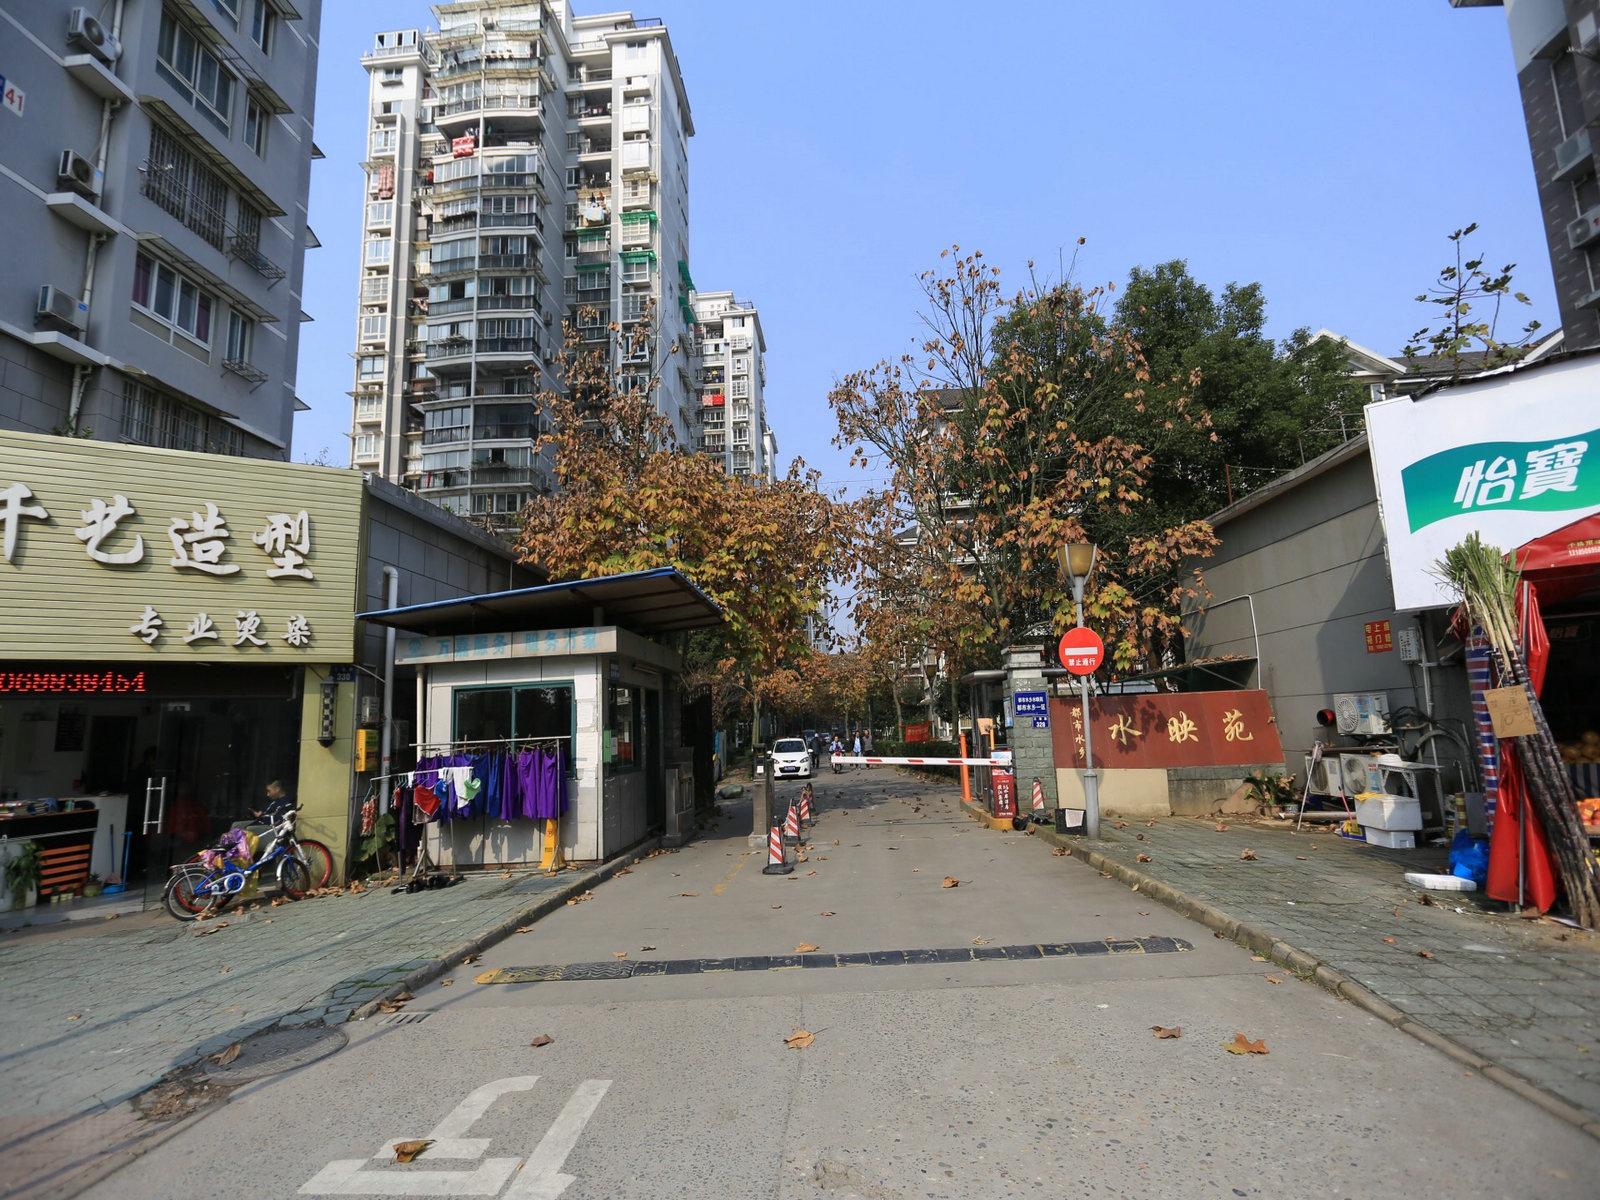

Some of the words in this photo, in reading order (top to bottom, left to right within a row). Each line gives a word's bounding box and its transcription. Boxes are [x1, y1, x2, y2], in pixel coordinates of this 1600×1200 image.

[5, 88, 23, 112] 41
[1453, 440, 1589, 509] 怡寶
[130, 606, 313, 646] 专业烫染
[1068, 657, 1096, 666] 禁止通行
[1069, 706, 1086, 760] 都市水乡
[1107, 708, 1254, 745] 水映苑
